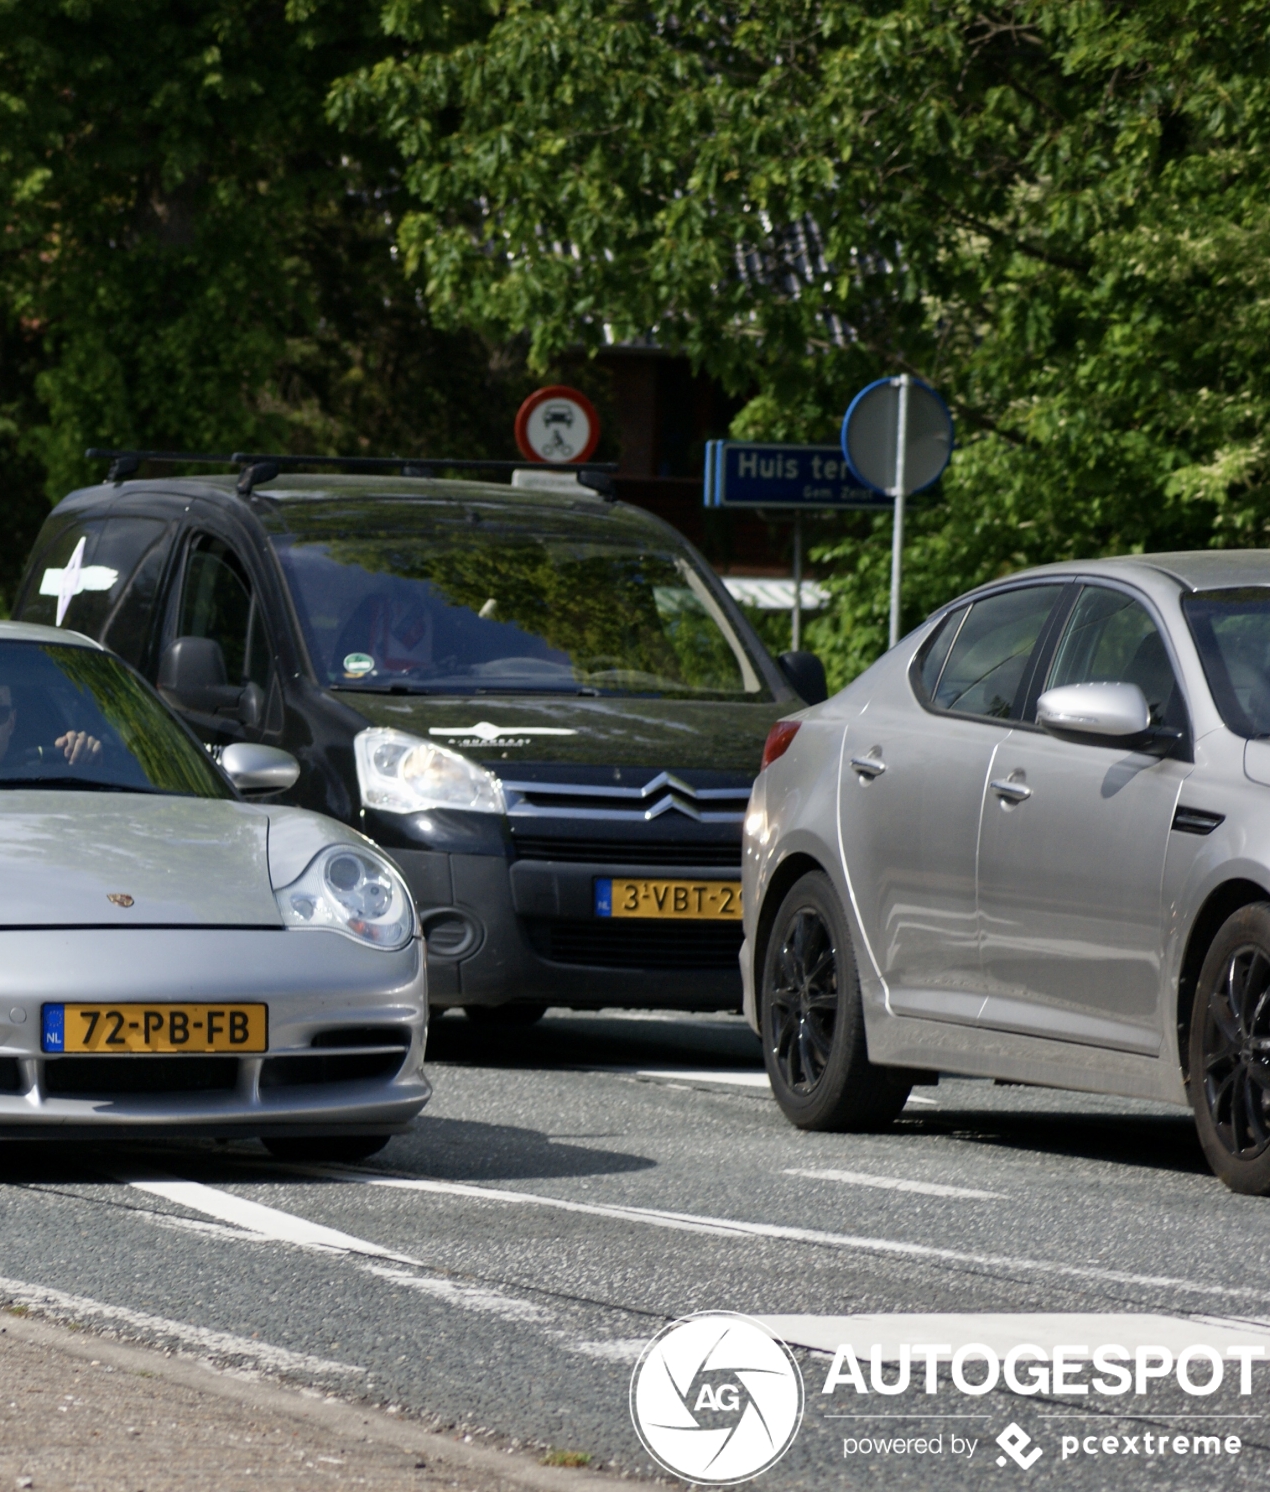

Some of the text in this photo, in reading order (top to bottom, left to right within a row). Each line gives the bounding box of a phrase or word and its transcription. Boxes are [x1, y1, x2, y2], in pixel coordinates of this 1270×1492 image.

[738, 452, 848, 480] Huis ter
[46, 1033, 61, 1044] NL
[80, 1011, 249, 1044] 72-PB-FB
